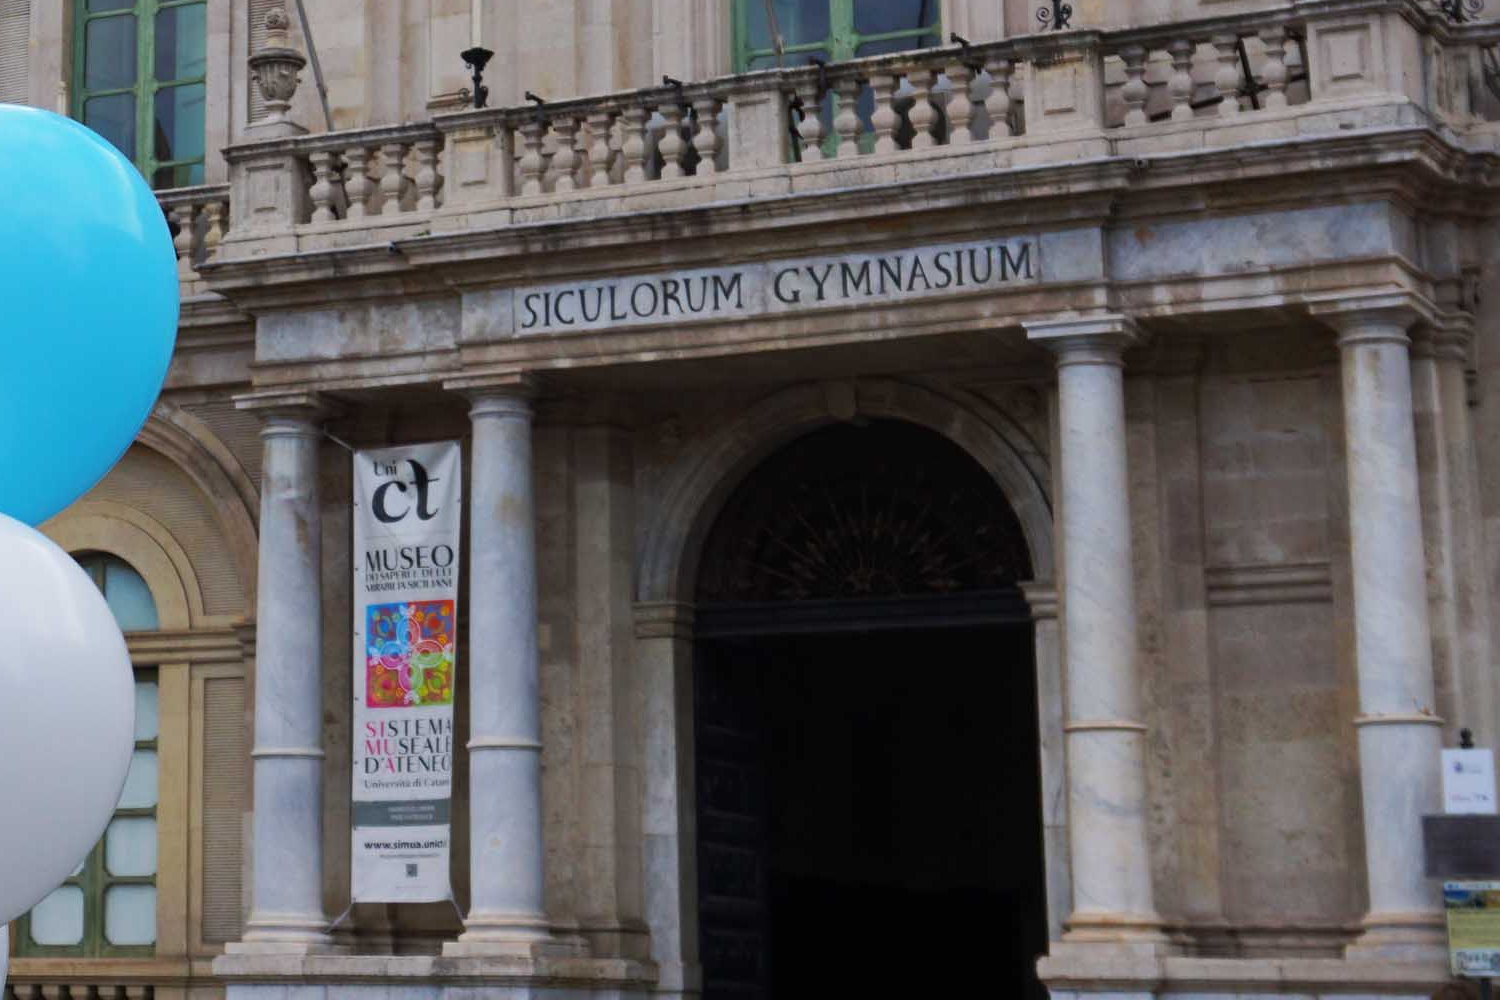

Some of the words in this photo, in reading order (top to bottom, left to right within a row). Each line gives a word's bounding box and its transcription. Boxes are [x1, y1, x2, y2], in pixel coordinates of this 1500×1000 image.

[521, 272, 744, 329] SICULORUM
[773, 242, 1035, 304] GYMNASIUM
[373, 460, 397, 477] Uni
[372, 458, 440, 524] ct
[365, 544, 454, 573] MUSEO
[365, 736, 452, 756] MUSEALE
